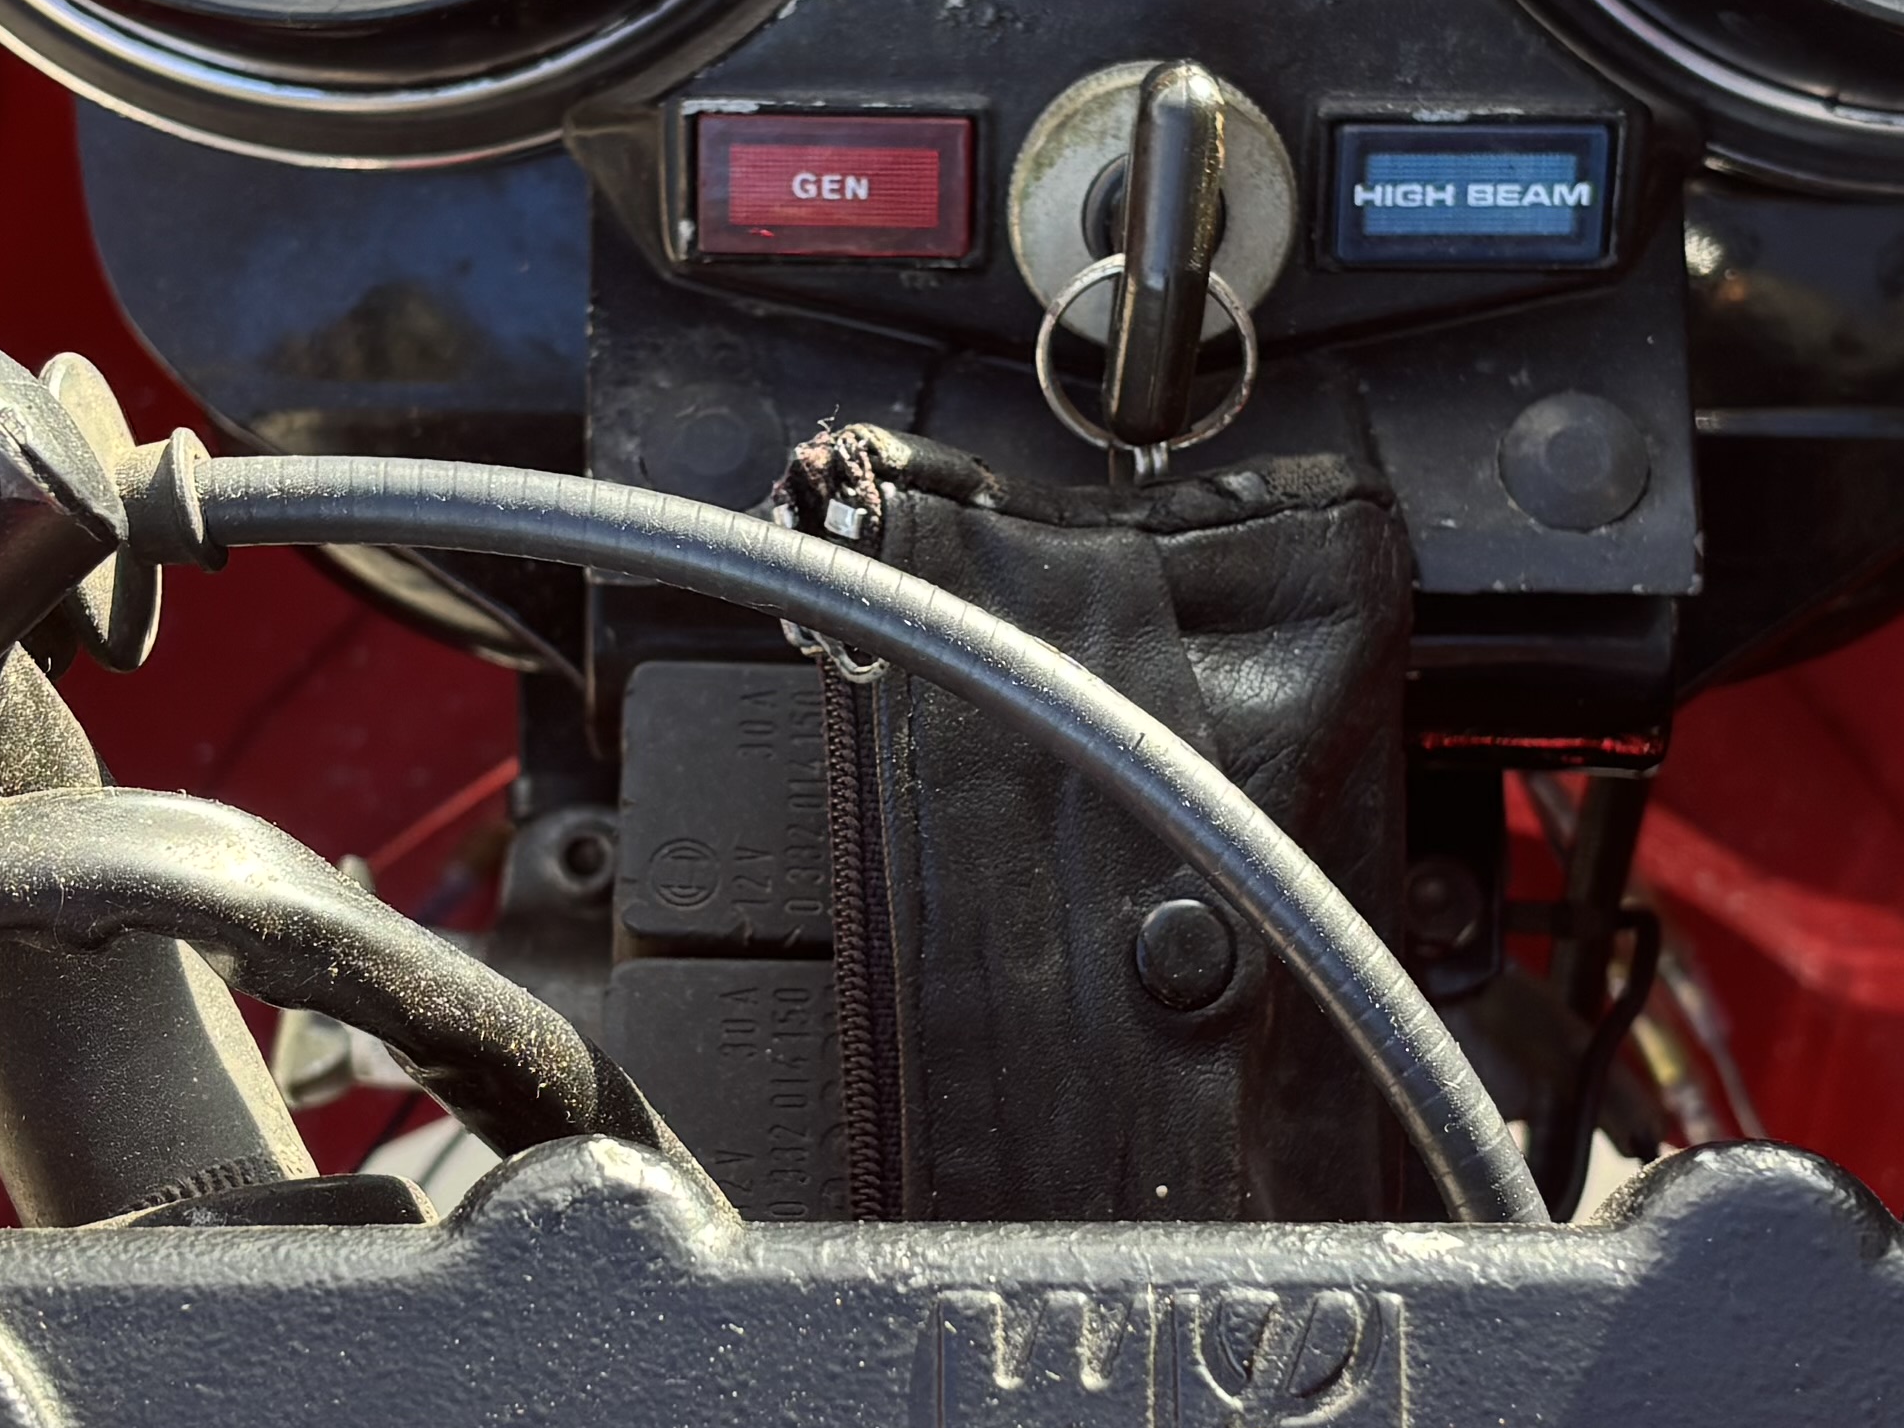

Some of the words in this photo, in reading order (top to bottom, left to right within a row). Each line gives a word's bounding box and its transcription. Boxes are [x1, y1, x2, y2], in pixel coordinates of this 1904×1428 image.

[791, 171, 868, 200] GEN
[1354, 182, 1456, 208] HIGH
[1467, 182, 1591, 207] BEAM
